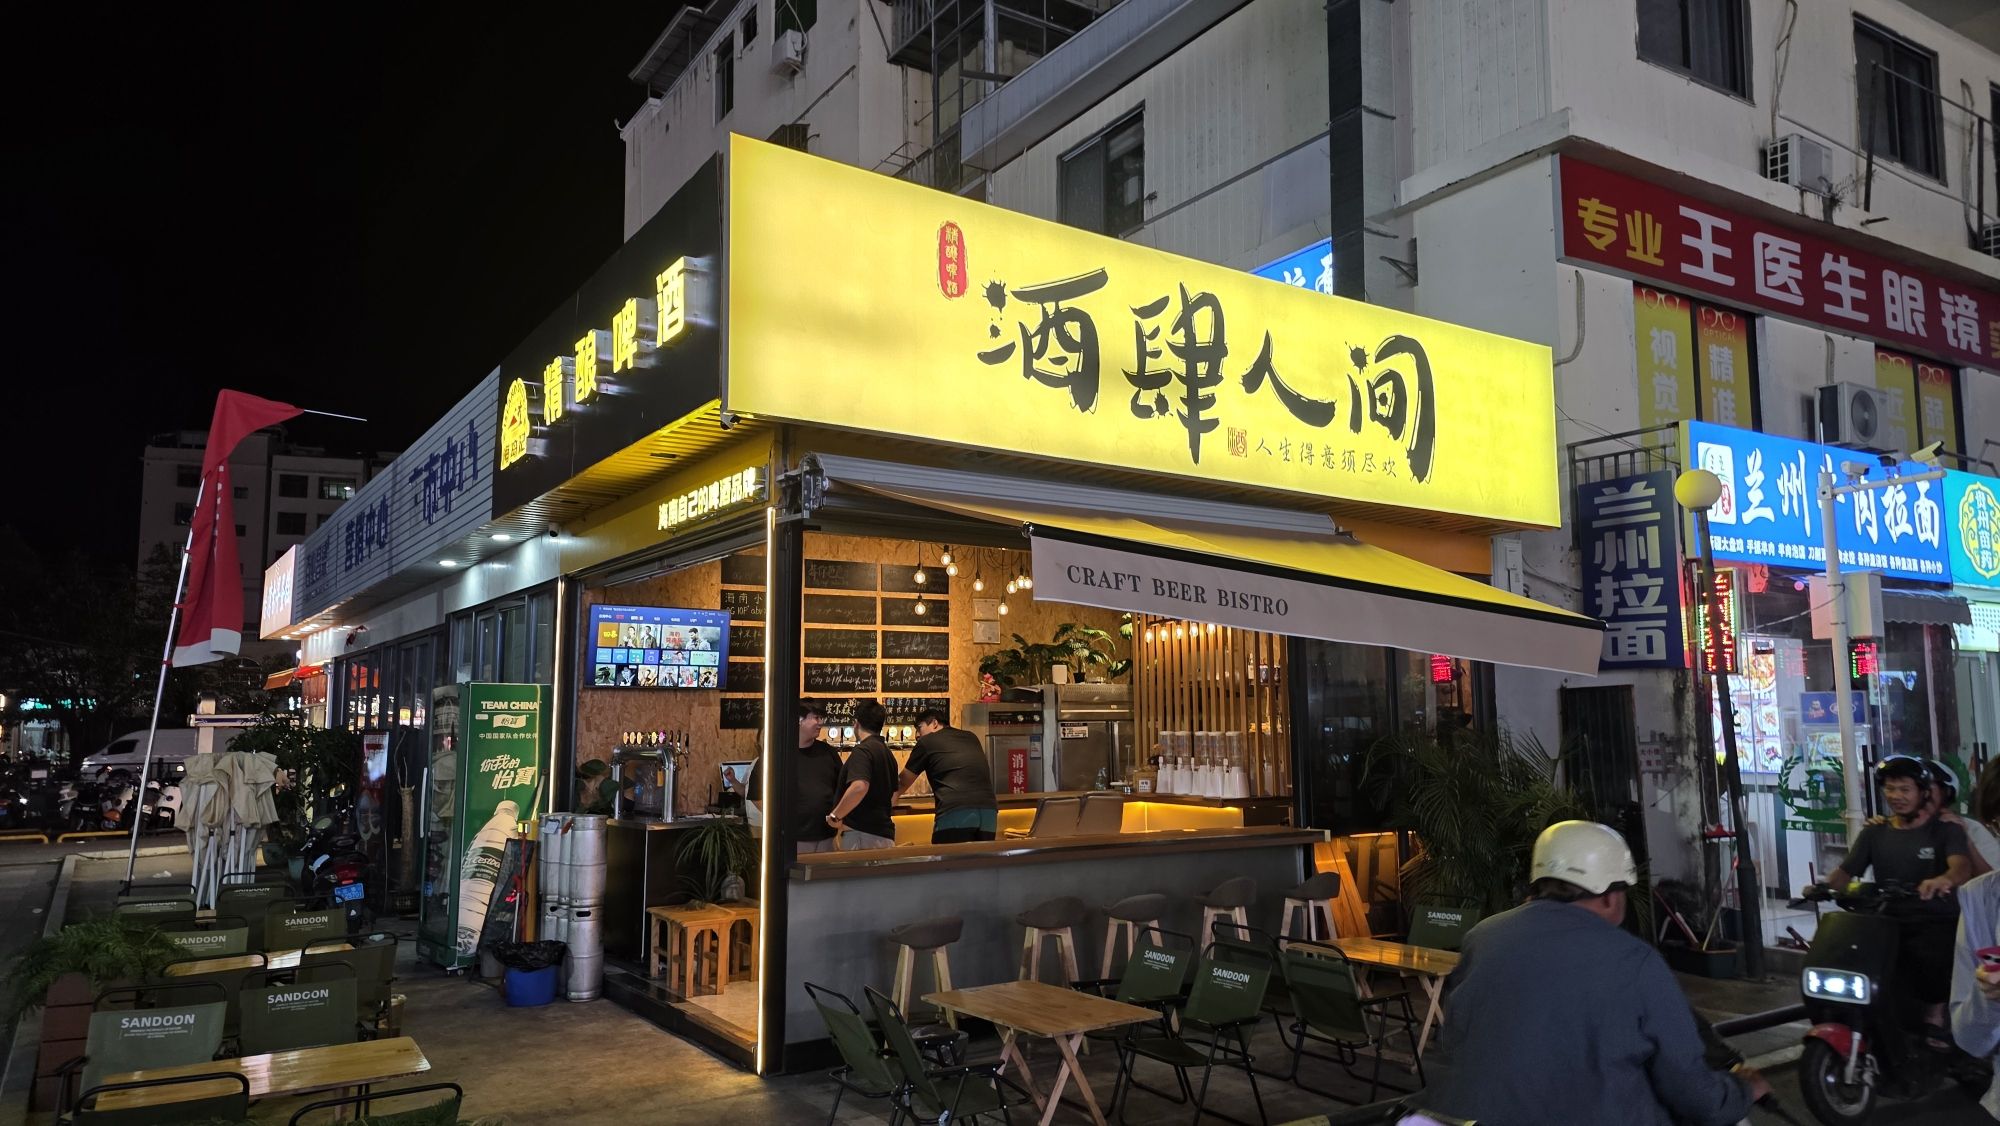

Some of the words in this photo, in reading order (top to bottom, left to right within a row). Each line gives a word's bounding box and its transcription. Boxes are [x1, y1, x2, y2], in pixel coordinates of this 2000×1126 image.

[1578, 197, 1665, 267] 专业
[1679, 204, 1983, 356] 王医生眼镜
[543, 256, 687, 427] 精酿啤酒
[977, 266, 1436, 484] 酒肆人间
[1255, 437, 1397, 478] 人生得意须尽欢
[1592, 481, 1668, 662] 兰州拉面
[1067, 564, 1141, 593] CRAFT
[1151, 577, 1208, 604] BEER
[1217, 588, 1289, 617] BISTRO
[481, 701, 508, 710] TEAM
[510, 701, 539, 710] CHINA
[479, 732, 538, 740] 中国国家队合作伙伴
[480, 754, 520, 773] 你我的
[285, 915, 328, 926] SANDOON
[1427, 911, 1462, 921] SANDOON
[174, 935, 227, 945] SANDOON
[1144, 950, 1175, 964] SANDOON
[1212, 967, 1250, 983] SANDOON
[267, 989, 329, 1004] SANDOON
[121, 1014, 195, 1028] SANDOON
